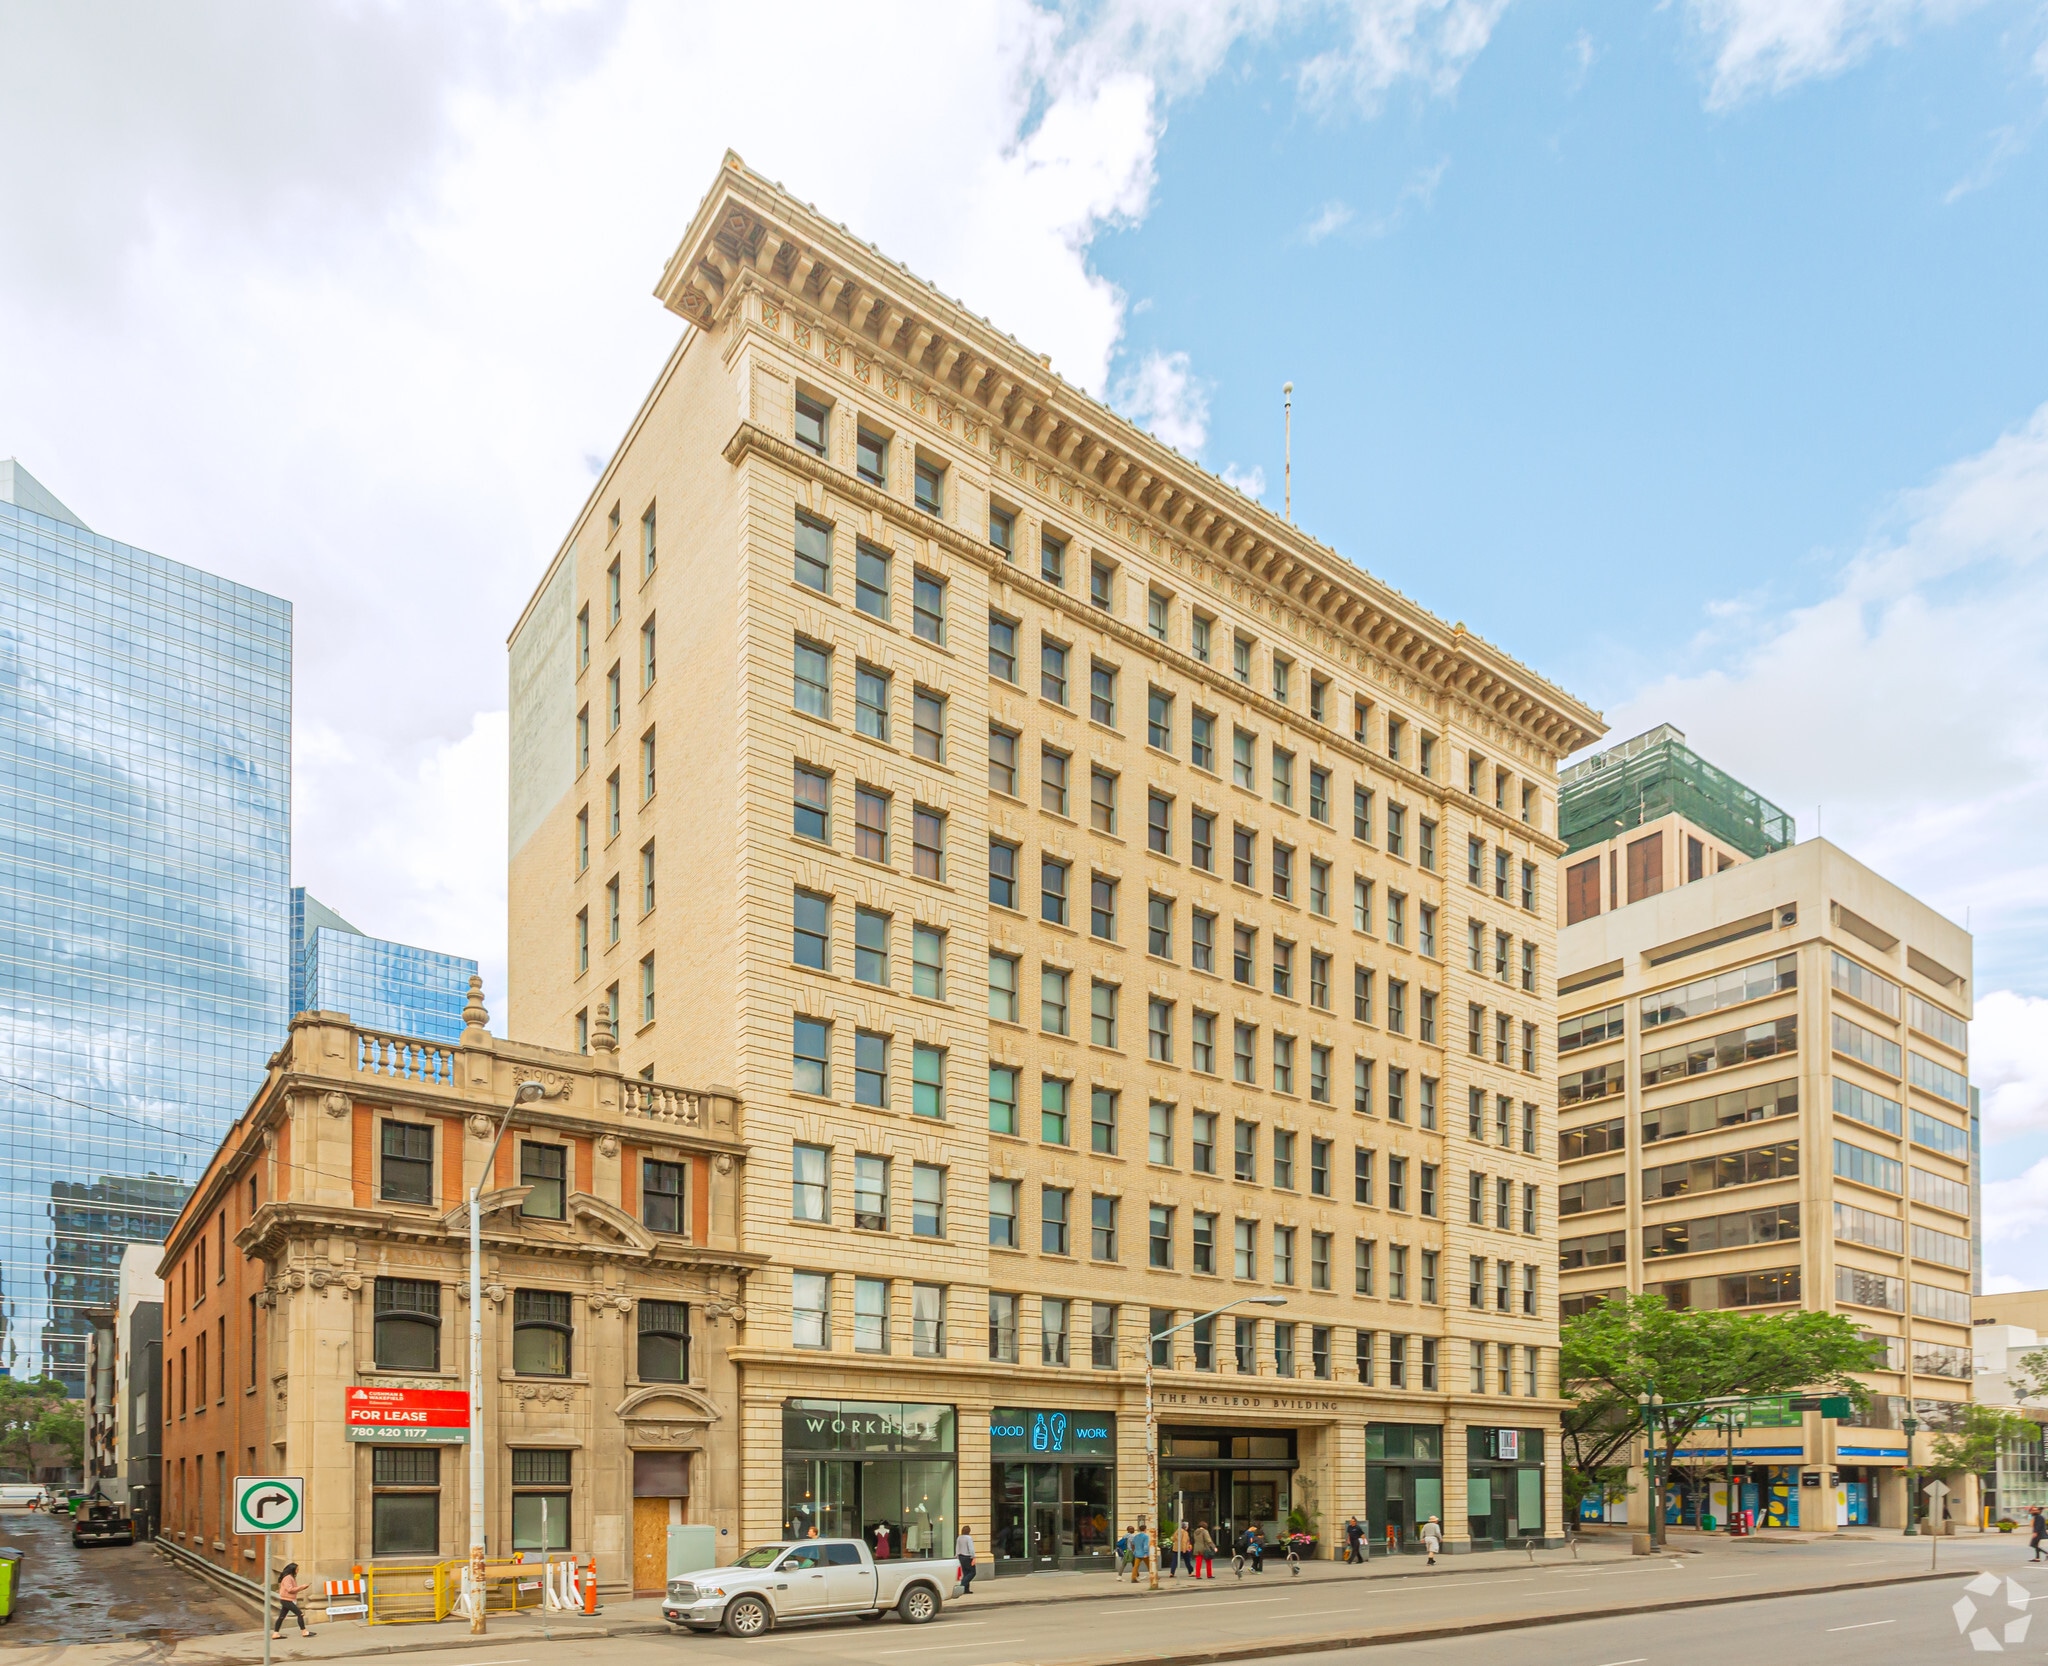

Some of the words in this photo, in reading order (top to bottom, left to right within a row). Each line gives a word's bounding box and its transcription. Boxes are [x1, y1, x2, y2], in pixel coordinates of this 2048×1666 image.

[530, 1069, 556, 1085] 1910
[1159, 1393, 1187, 1403] THE
[351, 1410, 381, 1420] FOR
[384, 1411, 428, 1422] LEASE
[806, 1418, 936, 1435] WORKHALL
[351, 1427, 375, 1437] 780
[377, 1428, 402, 1437] 420
[404, 1428, 428, 1438] 1177
[1075, 1428, 1108, 1439] WORK
